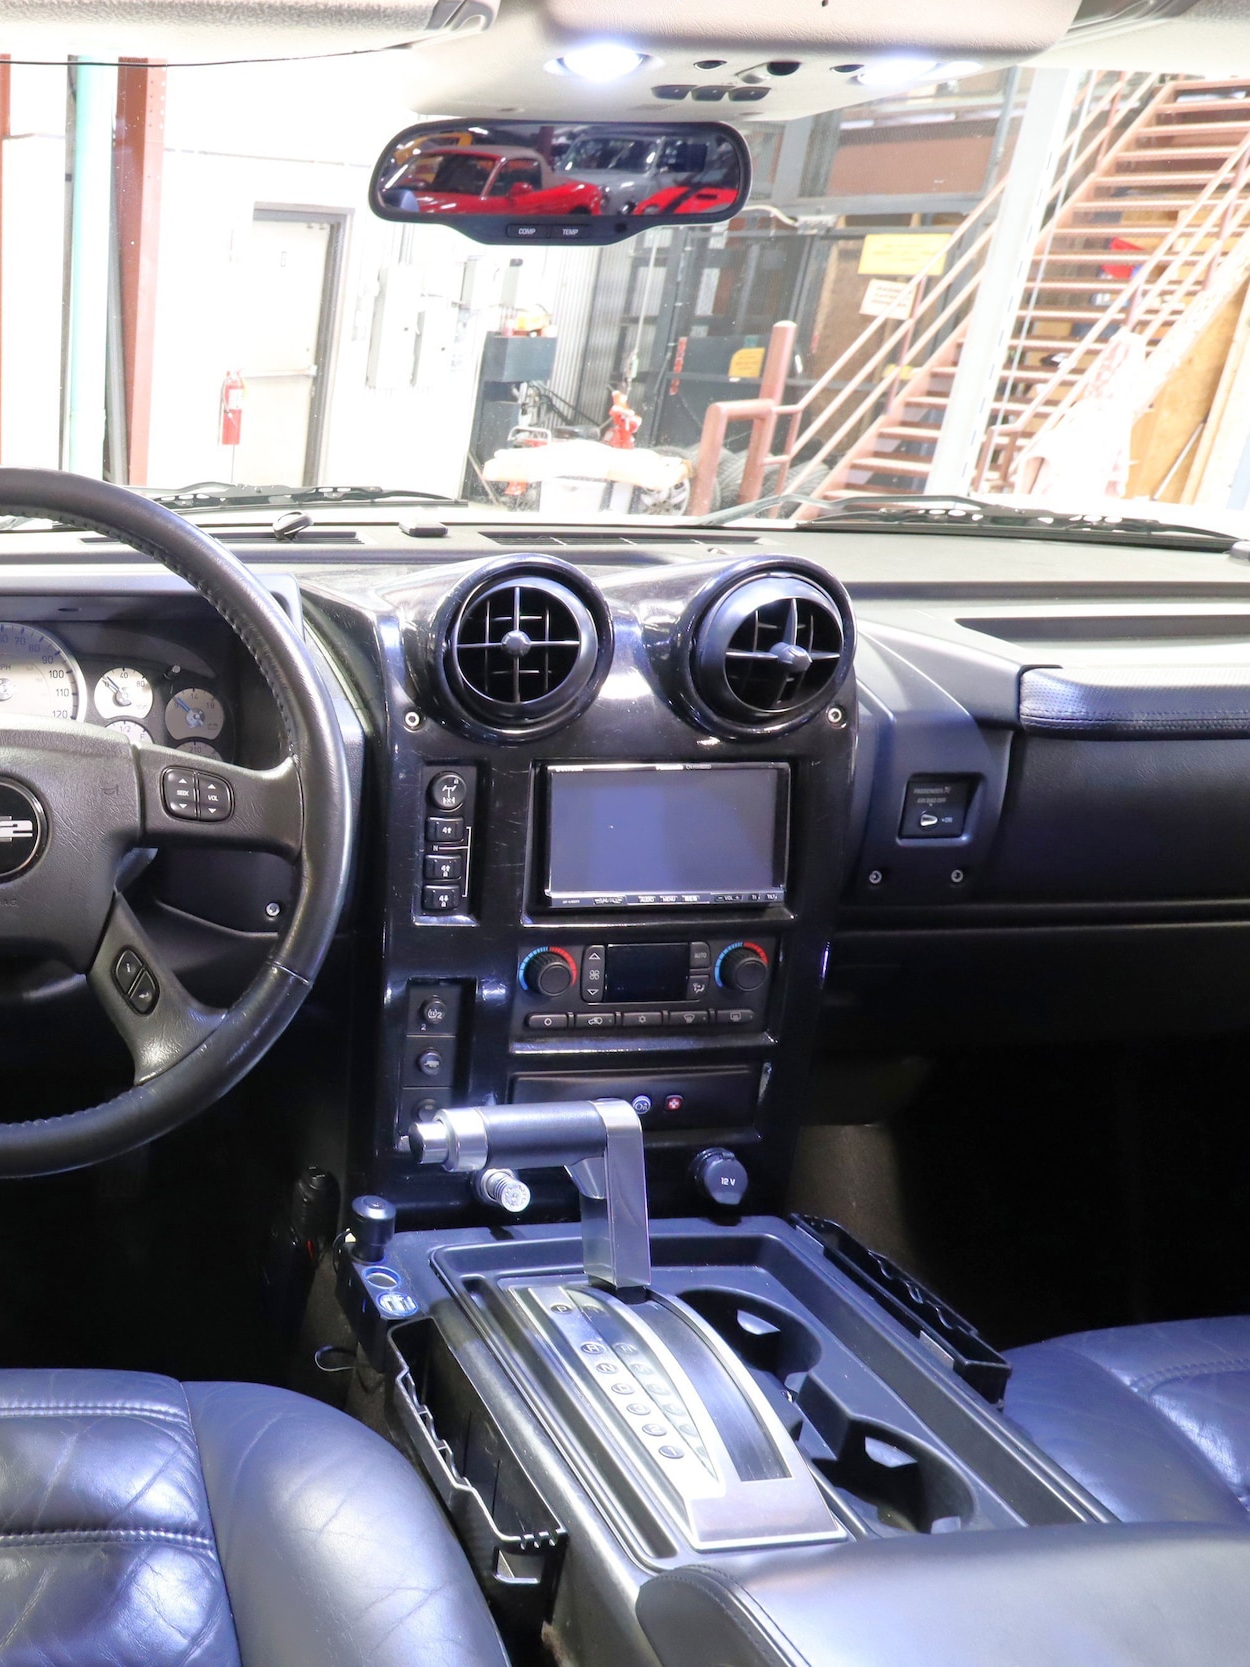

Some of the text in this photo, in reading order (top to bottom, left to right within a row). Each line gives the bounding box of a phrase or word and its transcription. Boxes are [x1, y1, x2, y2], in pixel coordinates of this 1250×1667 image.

[14, 636, 26, 646] 70
[28, 643, 40, 653] 80
[41, 655, 54, 665] 90
[49, 669, 65, 679] 100
[119, 671, 129, 679] 40
[136, 680, 146, 688] 80
[55, 688, 70, 698] 110
[190, 692, 199, 700] 14
[206, 702, 215, 710] 19
[52, 710, 68, 719] 120
[176, 789, 189, 797] SEEK
[436, 1011, 442, 1019] 2
[420, 1023, 427, 1031] 2
[721, 1176, 736, 1186] 12 V
